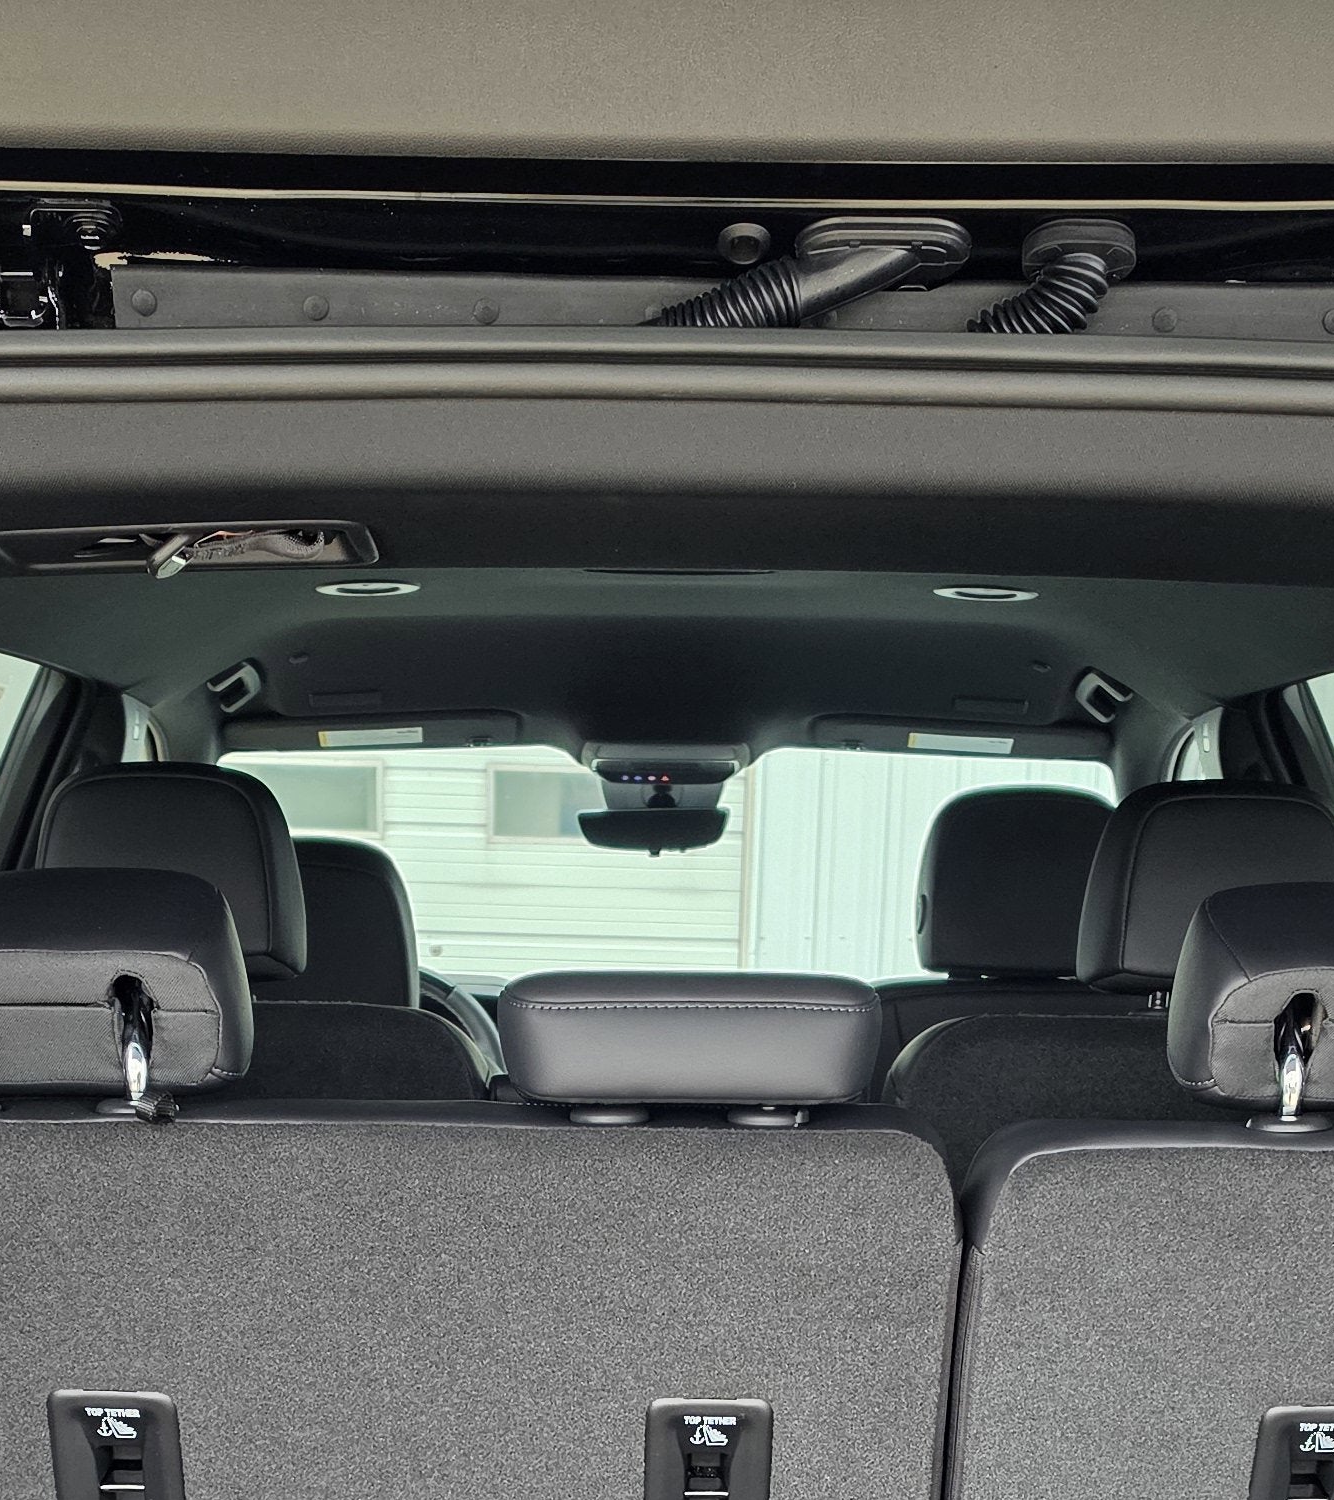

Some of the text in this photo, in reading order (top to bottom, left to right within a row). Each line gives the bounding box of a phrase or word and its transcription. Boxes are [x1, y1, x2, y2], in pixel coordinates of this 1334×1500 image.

[85, 1407, 141, 1418] TOP TETHER
[683, 1415, 737, 1426] TOP TETHER
[1299, 1422, 1318, 1432] TOP
